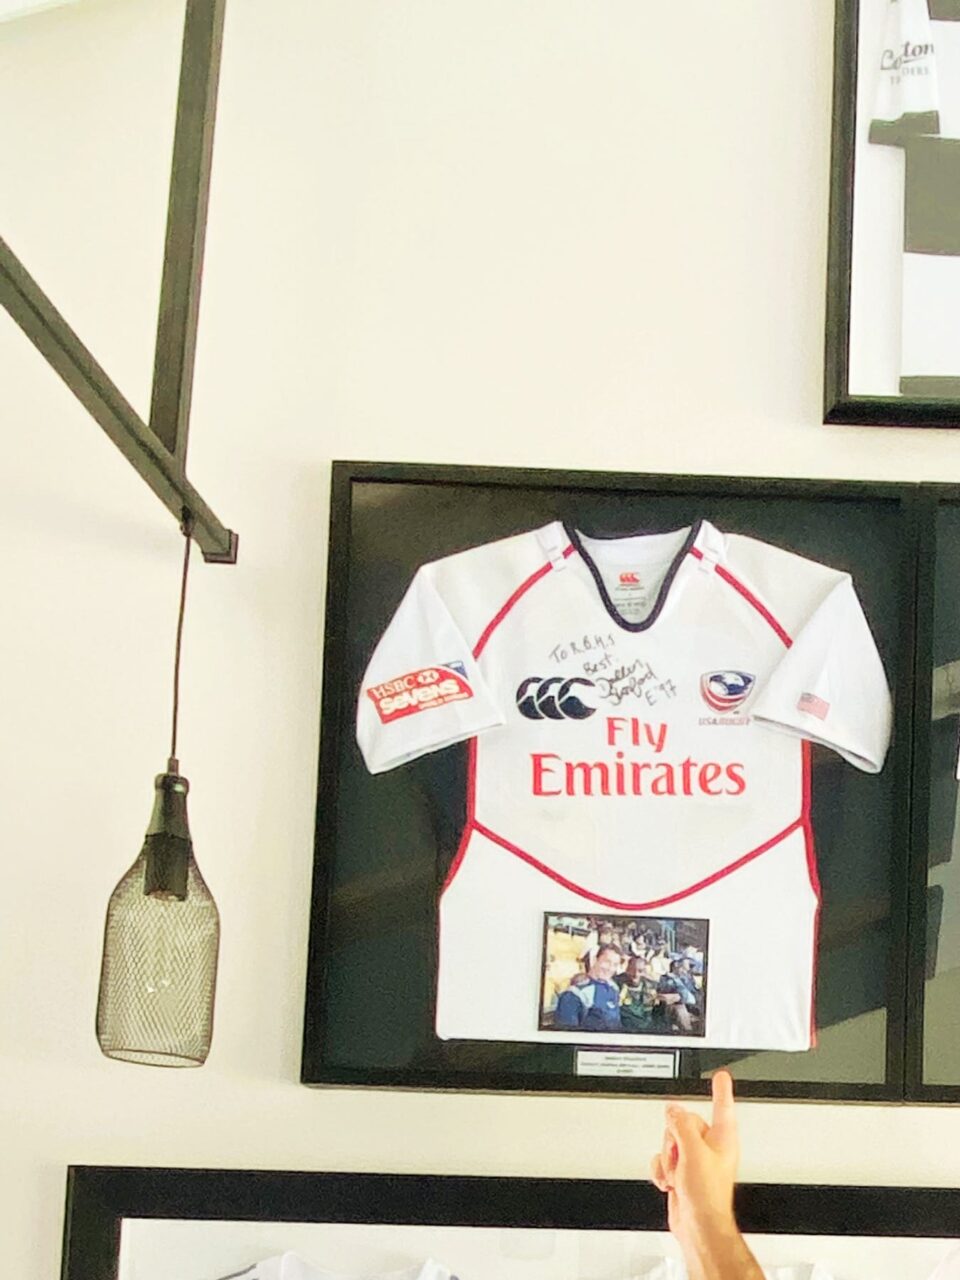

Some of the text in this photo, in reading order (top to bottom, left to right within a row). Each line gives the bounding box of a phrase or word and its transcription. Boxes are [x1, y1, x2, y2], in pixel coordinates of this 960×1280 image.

[371, 676, 416, 698] HSBC
[606, 716, 668, 752] Fly
[530, 751, 747, 796] Emirates
